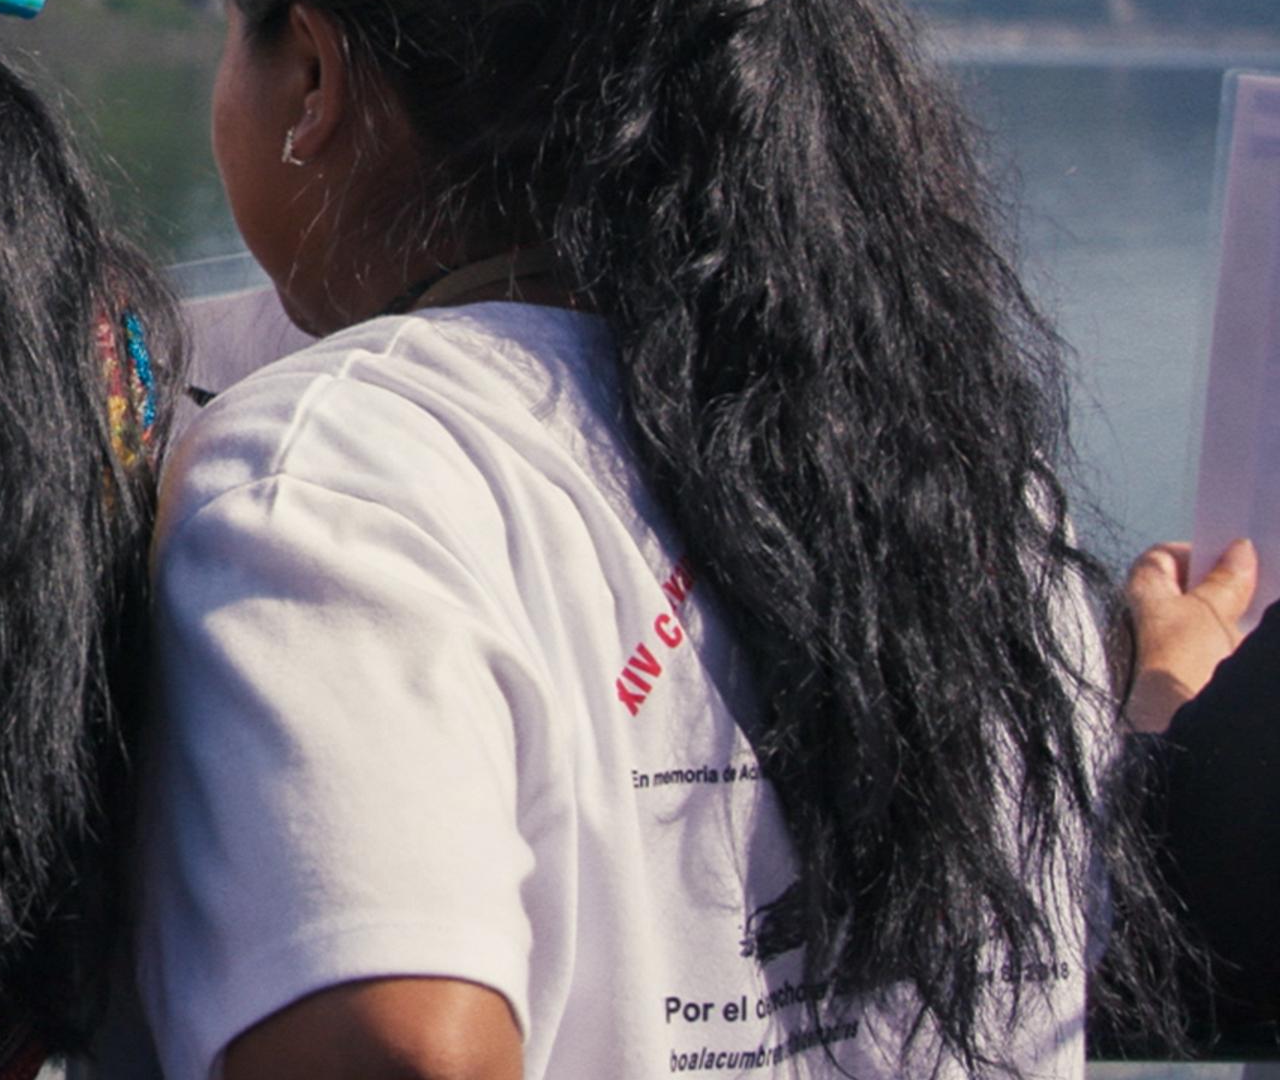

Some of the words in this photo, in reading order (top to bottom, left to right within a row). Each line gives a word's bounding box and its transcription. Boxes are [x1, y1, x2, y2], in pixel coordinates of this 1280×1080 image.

[614, 642, 663, 717] XIV
[631, 769, 650, 789] En
[653, 765, 719, 787] memoria
[665, 996, 715, 1025] Por
[722, 995, 747, 1023] el
